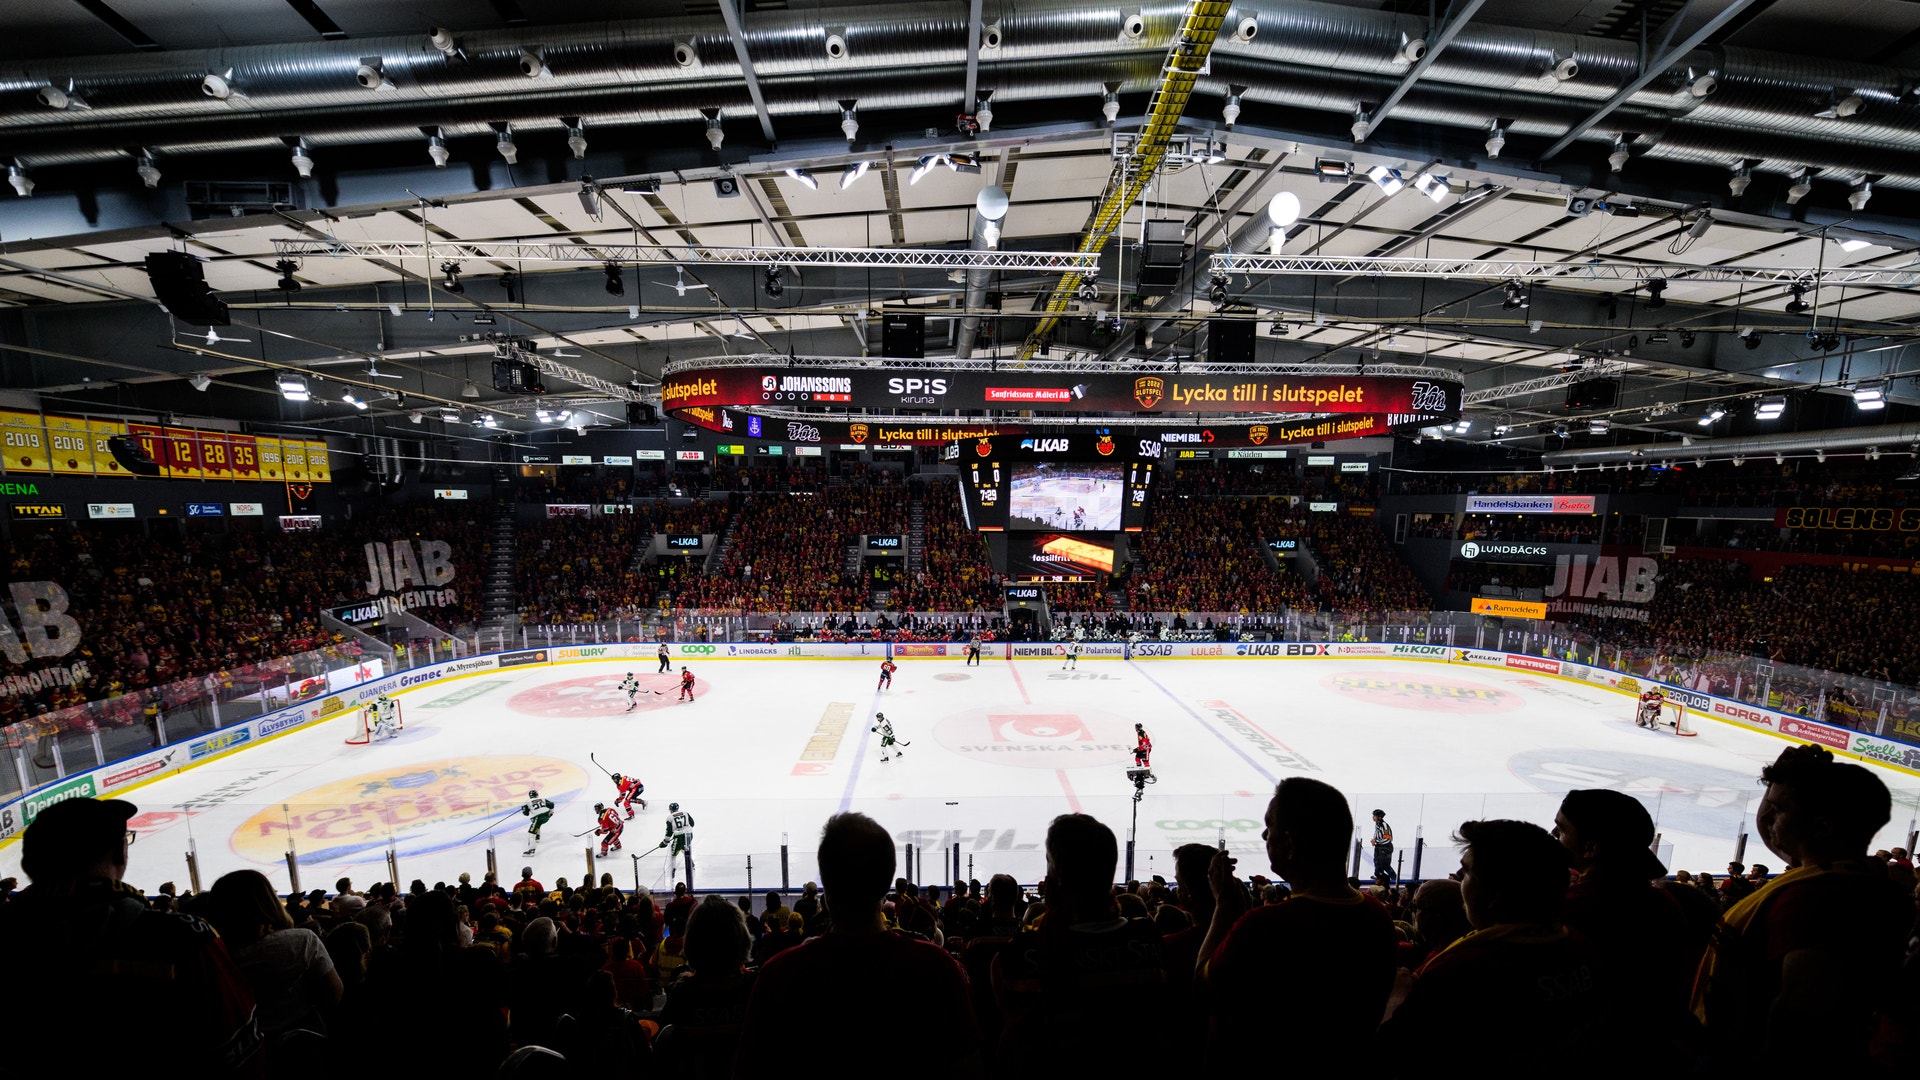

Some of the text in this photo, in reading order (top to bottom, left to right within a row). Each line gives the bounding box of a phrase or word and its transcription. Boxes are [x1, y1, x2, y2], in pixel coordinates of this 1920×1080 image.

[667, 378, 717, 401] slutspelet
[780, 377, 852, 392] JOHANSSONS
[991, 390, 1034, 399] Sanfridssons
[1059, 391, 1070, 399] AB
[1136, 388, 1162, 397] SLUTSPEL
[1172, 384, 1364, 406] Lycka till i slutspelet
[1280, 426, 1314, 440] Lycka
[1316, 423, 1331, 437] till
[1337, 417, 1374, 433] slutspelet
[5, 432, 40, 448] 2019
[879, 429, 913, 441] Lycka
[917, 429, 932, 440] till
[935, 429, 939, 440] i
[1161, 434, 1202, 442] NIEMI BIL
[54, 436, 85, 451] 2018
[142, 438, 155, 459] 4
[1034, 439, 1069, 452] LKAB
[1138, 440, 1161, 458] SSAB
[173, 442, 192, 462] 12
[204, 444, 226, 464] 28
[234, 446, 254, 466] 35
[261, 452, 281, 463] 1996
[681, 452, 699, 460] ABB
[286, 454, 304, 465] 2012
[310, 455, 327, 465] 2015
[973, 469, 1000, 483] 0 0
[980, 489, 997, 501] 7:29
[15, 505, 62, 514] TITAN
[1473, 499, 1591, 510] Handelsbanken Bistro
[549, 506, 576, 516] MAXI
[283, 519, 310, 529] MAXI
[1786, 507, 1894, 531] SOLENS
[678, 538, 699, 546] LKAB
[878, 538, 898, 547] LKAB
[1481, 545, 1547, 556] LUNDBÄCKS
[364, 540, 456, 595] JIAB
[1545, 554, 1659, 603] JIAB
[1016, 589, 1038, 598] LKAB
[352, 605, 379, 622] LKAB
[1493, 603, 1539, 614] Ramudden
[558, 647, 607, 659] SUBWAY
[681, 645, 716, 655] coop
[1014, 648, 1054, 656] NIEMI BIL
[1085, 646, 1122, 655] Polarbröd
[1139, 645, 1173, 656] SSAB
[1247, 644, 1280, 656] LKAB
[1286, 644, 1330, 656] BDX
[1393, 645, 1446, 656] HiKOKI
[1469, 654, 1502, 662] AXELENT
[456, 659, 493, 672] Myresjöhus
[1507, 657, 1559, 672] SVETRUCK
[401, 669, 442, 687] Granec
[1669, 689, 1710, 710] PROJOB
[1714, 703, 1773, 727] BORGA
[1797, 728, 1846, 745] Arkivexperten.se
[960, 743, 1135, 753] SVENSKA SPE
[1853, 737, 1904, 760] Snells
[306, 779, 546, 840] GULD
[674, 815, 688, 829] 67
[1155, 818, 1263, 833] coop
[895, 829, 1041, 851] SHL
